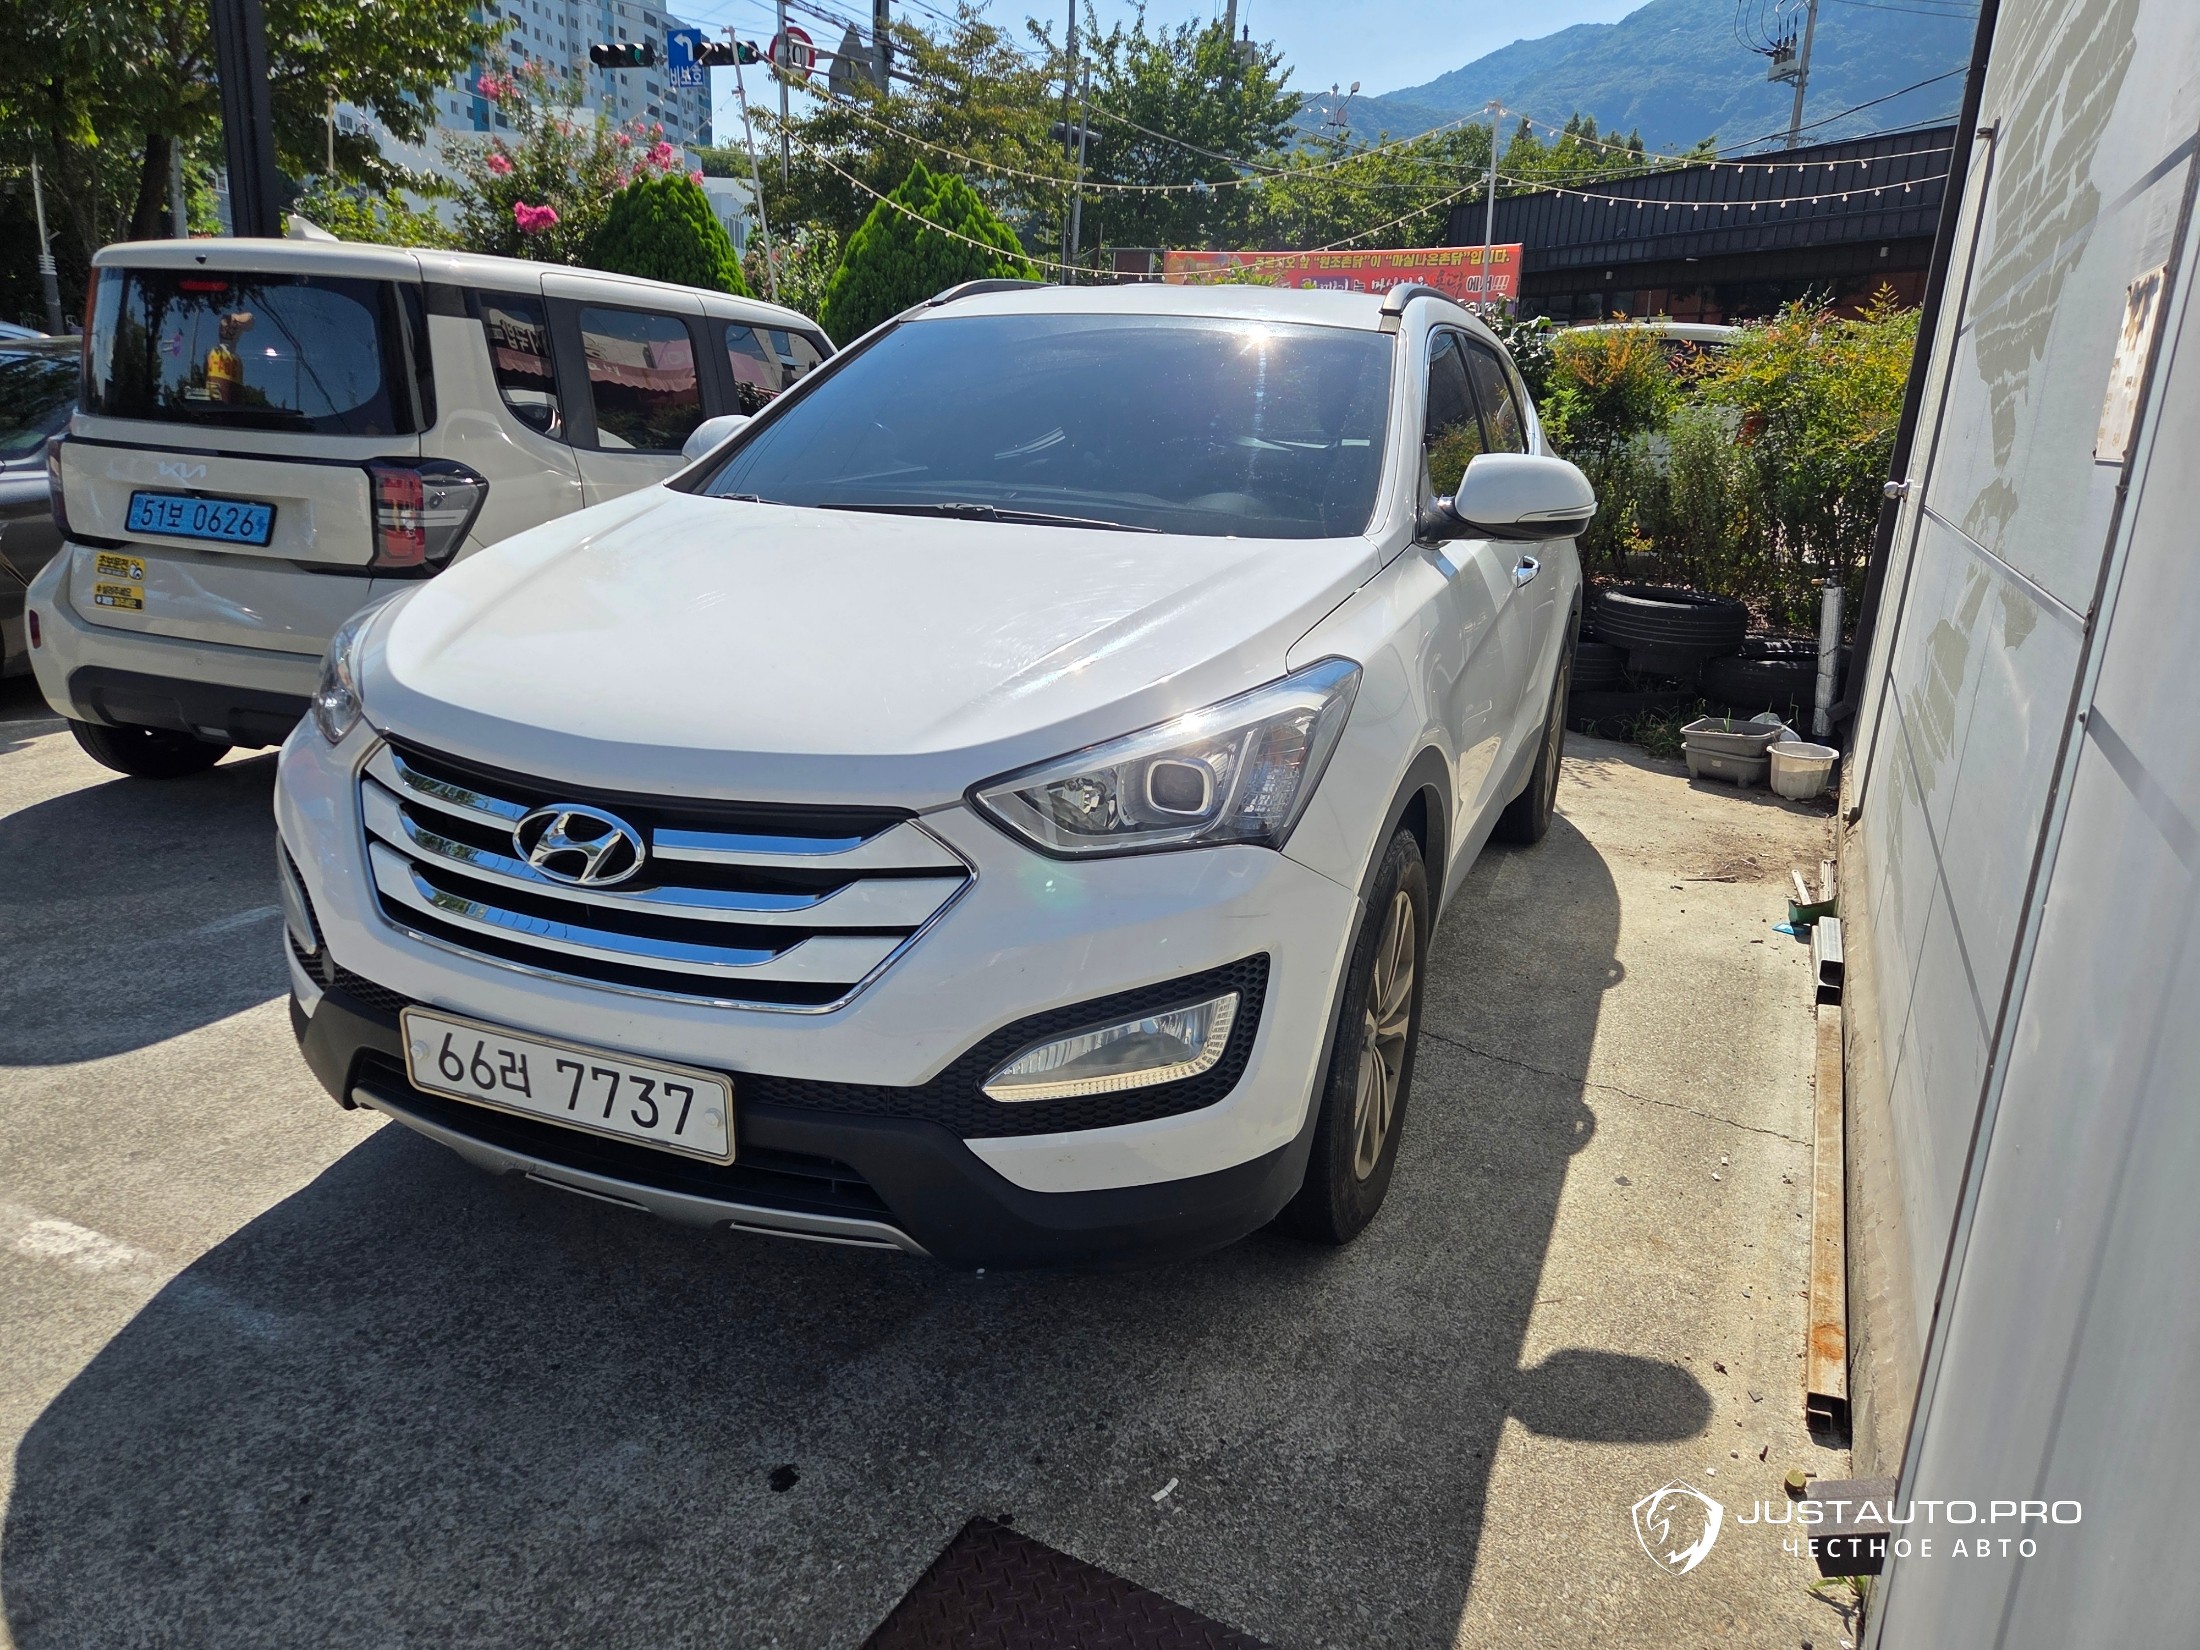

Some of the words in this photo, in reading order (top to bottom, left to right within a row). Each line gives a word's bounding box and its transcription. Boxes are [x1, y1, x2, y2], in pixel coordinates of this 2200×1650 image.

[670, 65, 703, 87] 비보호
[1299, 256, 1311, 269] 앞
[140, 499, 184, 528] 51보
[193, 504, 254, 537] 0626
[438, 1032, 532, 1098] 66러
[556, 1058, 694, 1135] 7737
